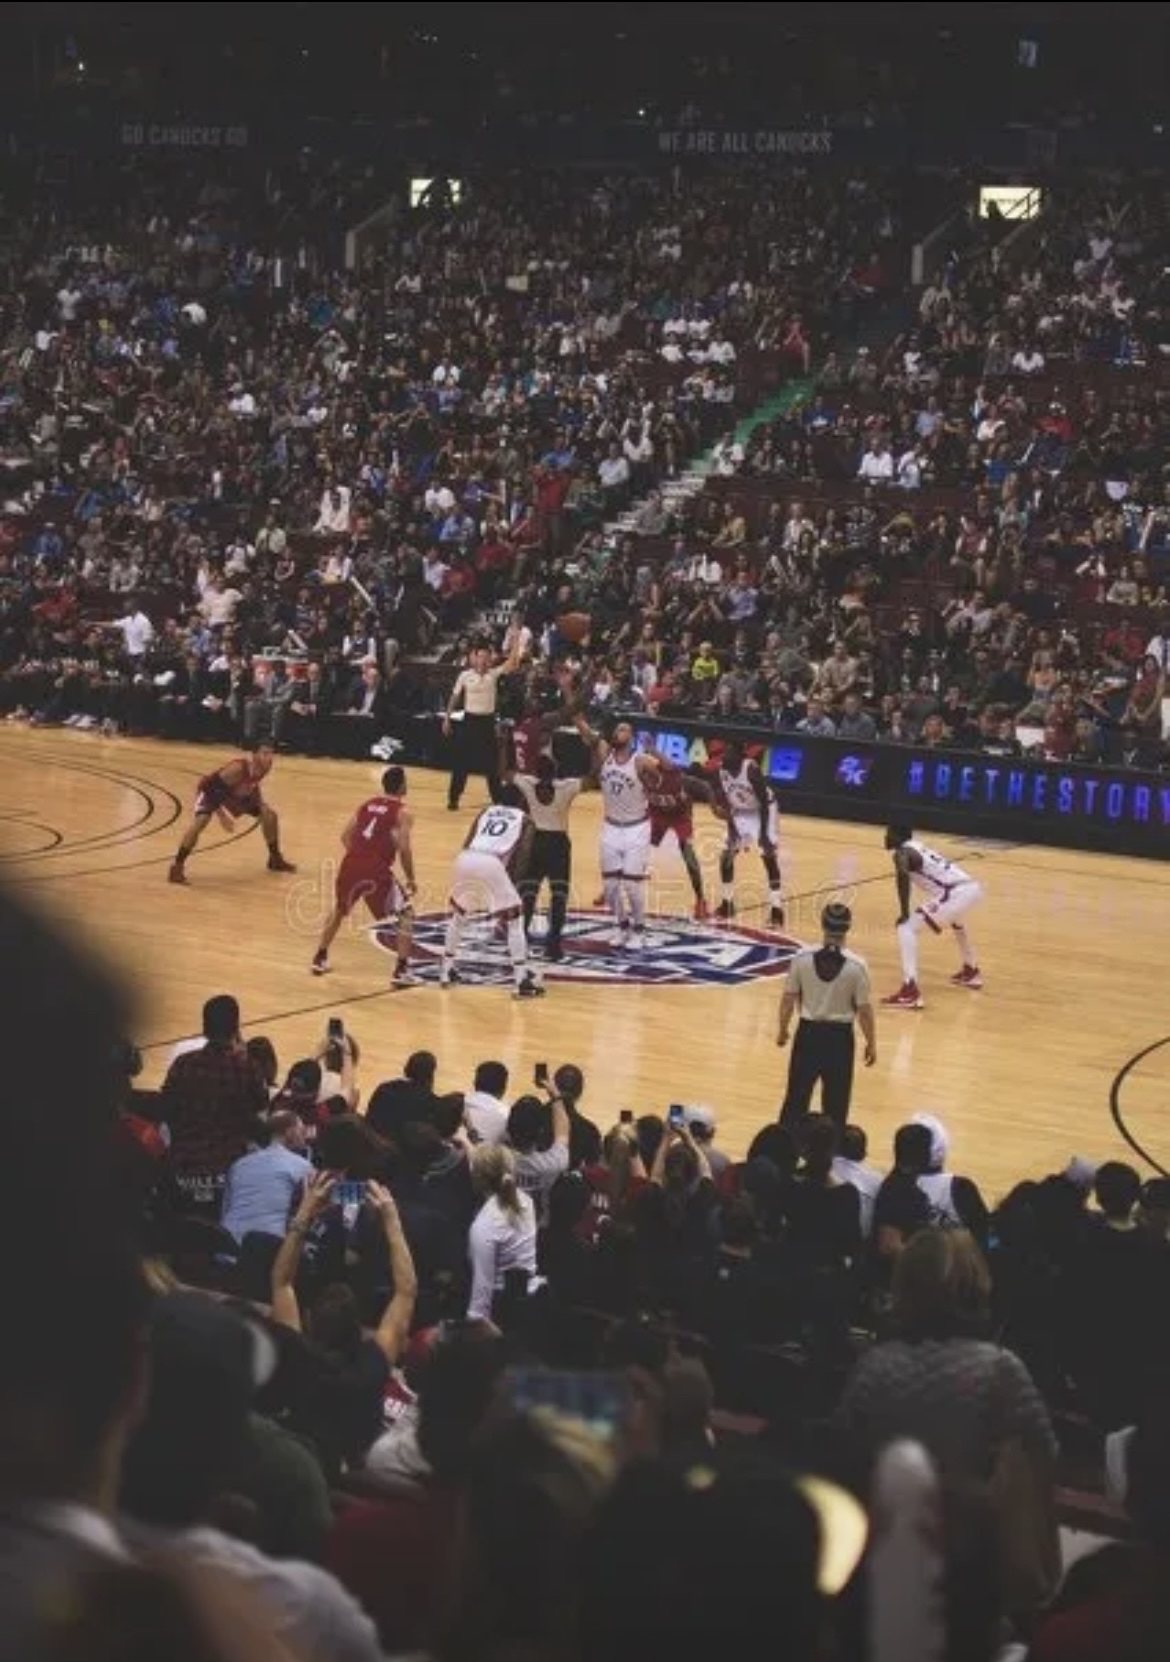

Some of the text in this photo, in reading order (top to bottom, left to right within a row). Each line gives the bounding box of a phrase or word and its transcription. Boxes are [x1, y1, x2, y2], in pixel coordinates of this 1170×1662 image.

[659, 131, 833, 155] WE ARE ALL CANUCKS
[481, 818, 509, 837] 10
